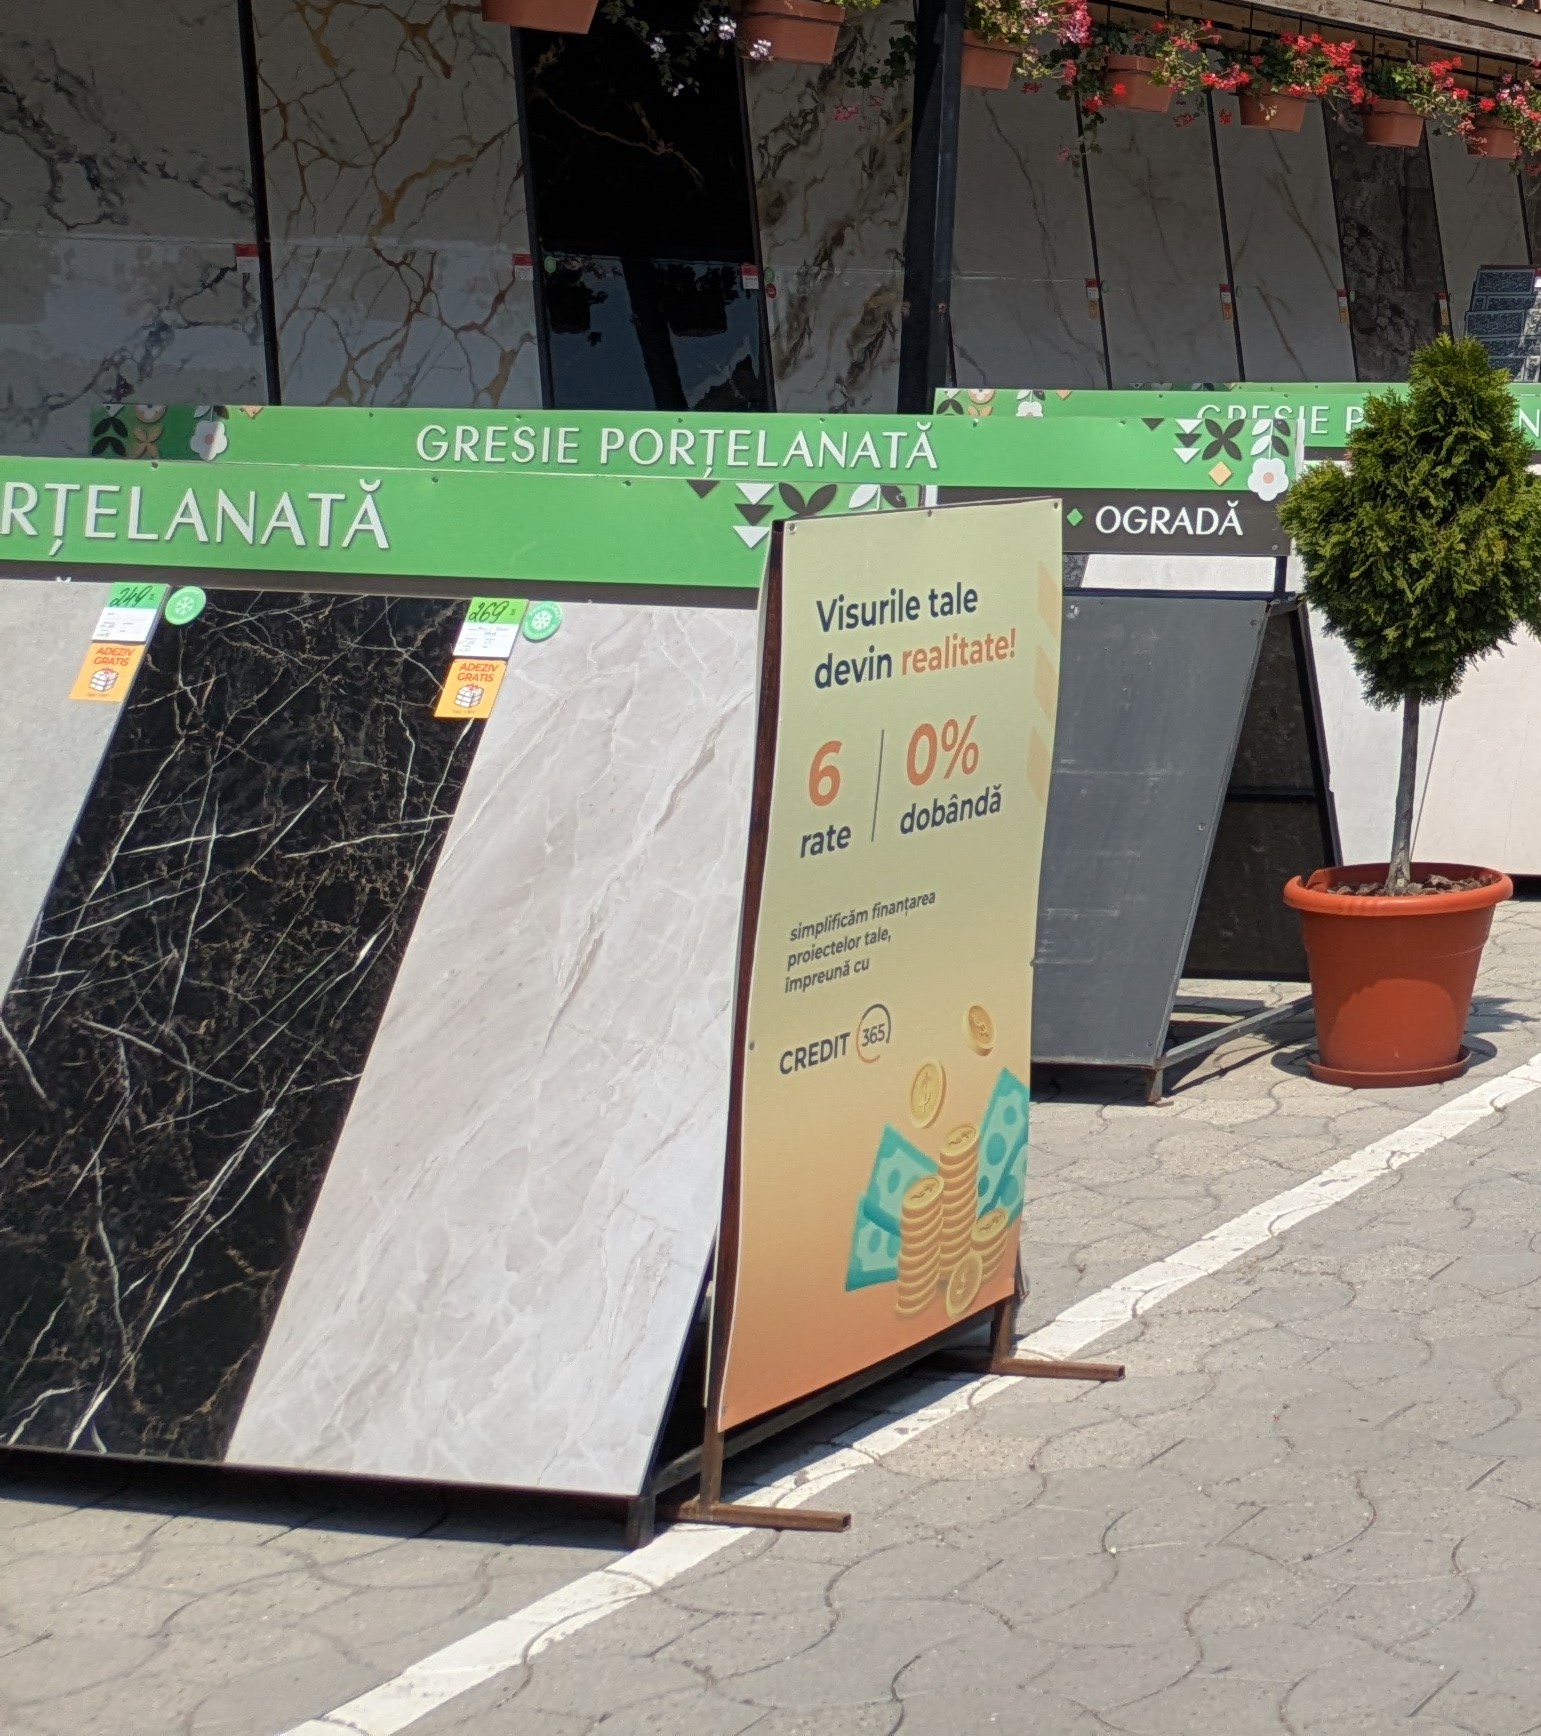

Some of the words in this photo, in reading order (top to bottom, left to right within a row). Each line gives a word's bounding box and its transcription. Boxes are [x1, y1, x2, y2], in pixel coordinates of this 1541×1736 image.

[415, 424, 581, 465] GRESIE
[599, 421, 939, 480] PORȚELANATĂ
[1095, 499, 1244, 536] OGRADĂ
[109, 584, 154, 608] 249
[468, 600, 510, 625] 269
[815, 586, 921, 633] Visurile
[928, 581, 979, 619] tale
[93, 657, 131, 667] GRATIS
[95, 646, 136, 657] ADEZIV
[458, 662, 500, 672] ADEZIV
[814, 644, 893, 690] devin
[901, 627, 1017, 676] realitate!
[456, 672, 495, 683] GRATIS
[905, 714, 980, 787] 0%
[808, 739, 843, 807] 6
[899, 783, 1003, 836] dobândă
[799, 824, 852, 859] rate
[789, 908, 869, 942] simplificăm
[872, 890, 937, 917] finanțarea
[786, 935, 862, 972] proiectelor
[864, 926, 892, 947] tale,
[784, 959, 851, 994] împreună
[853, 957, 871, 974] cu
[779, 1031, 851, 1076] CREDIT
[861, 1022, 886, 1048] 365
